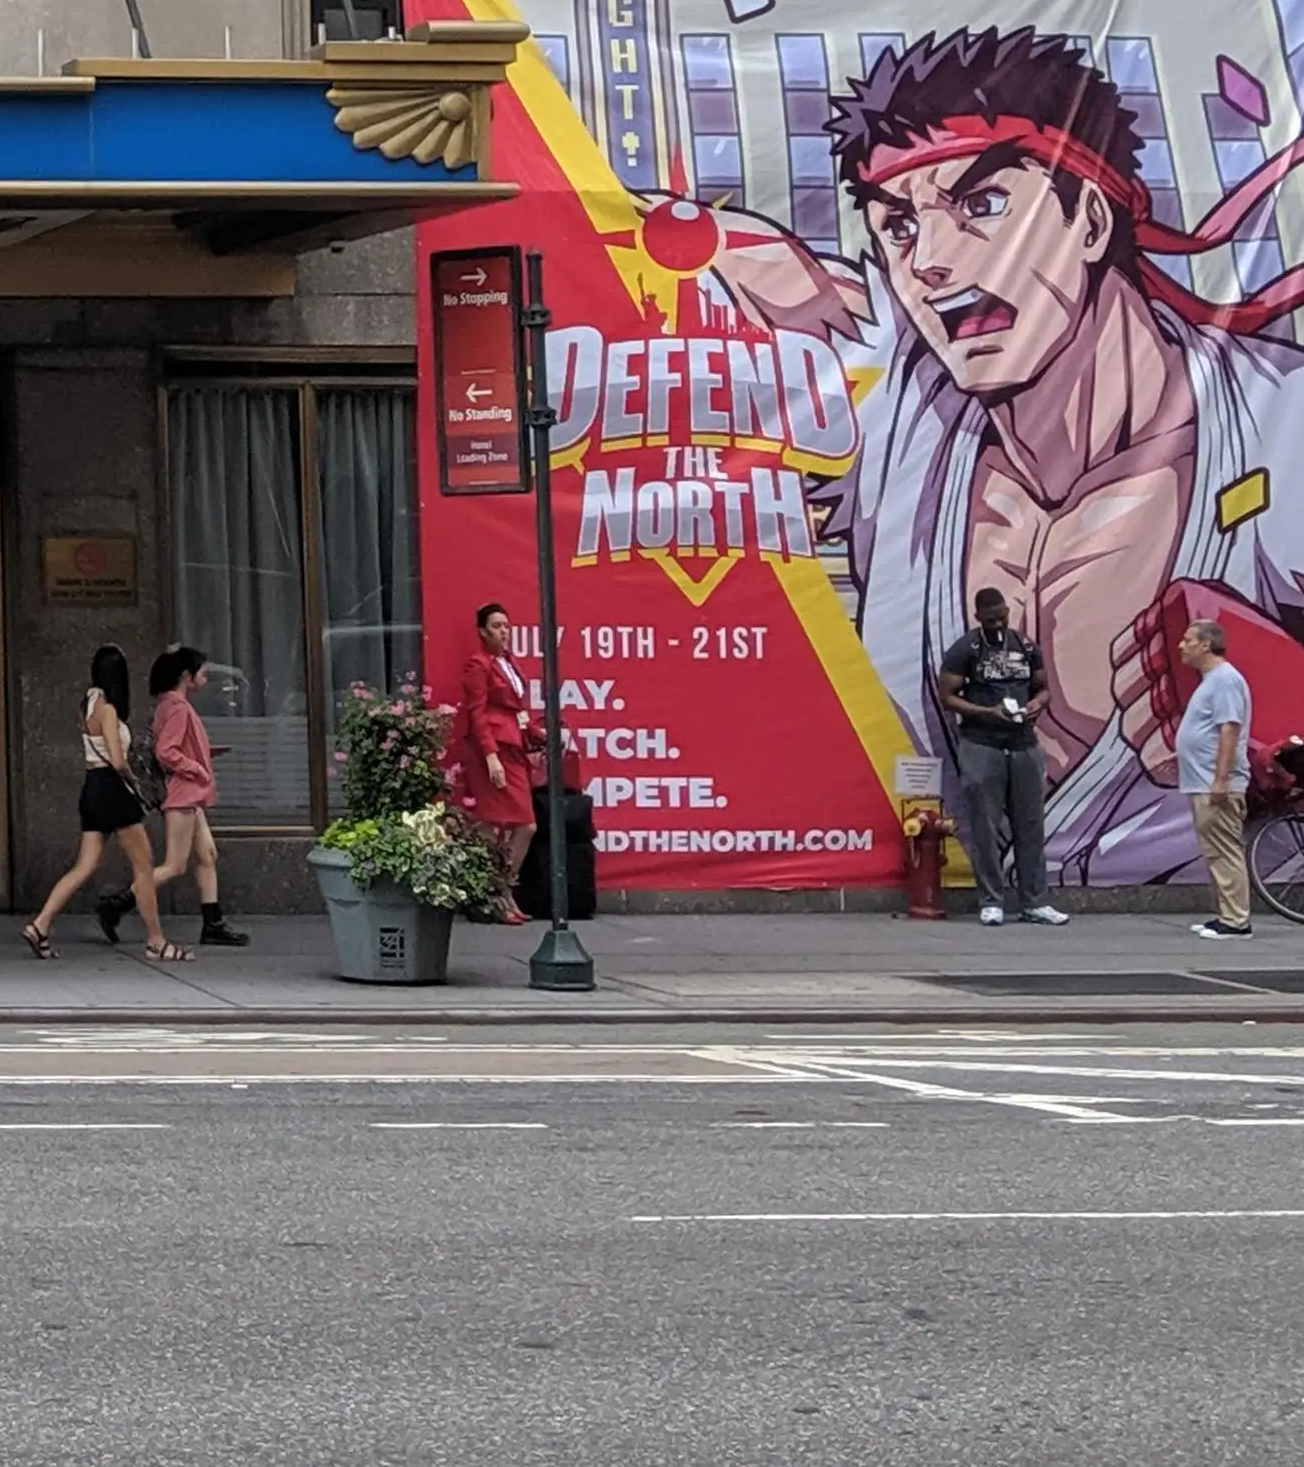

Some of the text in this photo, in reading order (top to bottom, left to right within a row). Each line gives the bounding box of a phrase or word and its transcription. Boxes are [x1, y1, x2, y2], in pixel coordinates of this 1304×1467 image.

[443, 294, 459, 306] No
[532, 324, 858, 459] DEFEND
[448, 406, 512, 422] No Standing
[663, 446, 730, 480] THE
[576, 467, 815, 558] NORTH
[580, 625, 655, 659] 19TH
[692, 625, 769, 660] 21ST
[529, 678, 626, 711] LAY.
